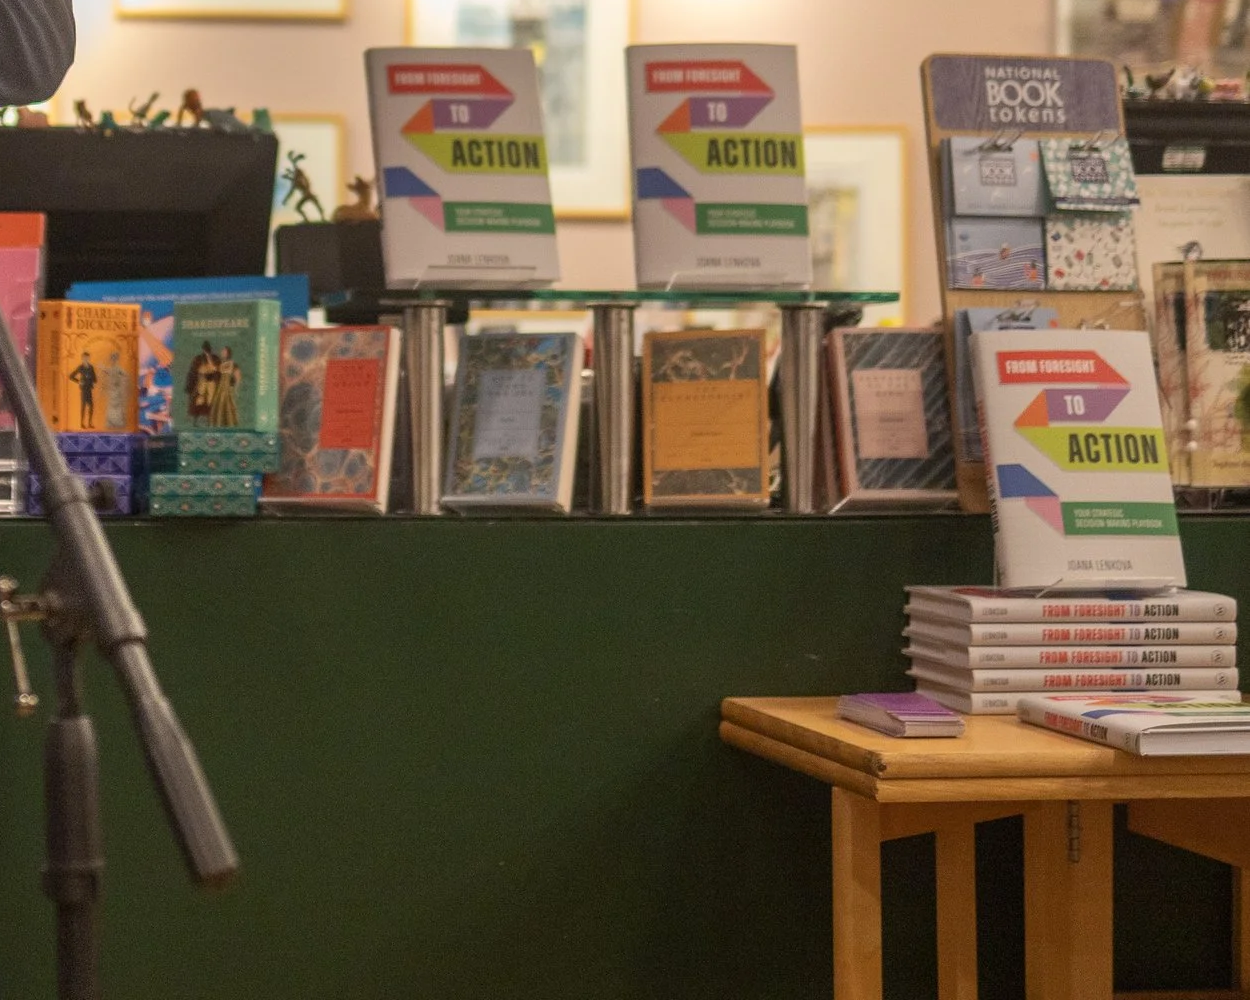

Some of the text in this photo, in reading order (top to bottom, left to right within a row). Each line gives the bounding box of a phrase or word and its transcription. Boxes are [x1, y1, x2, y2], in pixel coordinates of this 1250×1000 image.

[984, 66, 1060, 80] NATIONAL
[986, 80, 1064, 107] BOOK
[449, 103, 470, 124] TO
[707, 102, 728, 123] TO
[989, 107, 1066, 123] tokens
[452, 139, 541, 169] ACTION
[707, 138, 798, 169] ACTION
[76, 306, 128, 319] CHARLES
[76, 319, 128, 331] DICKENS
[181, 317, 249, 330] SHAKESPEARE
[1005, 359, 1096, 374] FROM FORESIGHT
[1063, 395, 1086, 416] TO
[1068, 433, 1160, 464] ACTION
[1042, 605, 1179, 618] FROM FORESIGHT TO ACTION
[1041, 628, 1179, 641] FROM FORESIGHT TO ACTION
[1039, 651, 1177, 664] FROM FORESIGHT TO ACTION
[1043, 674, 1181, 687] FROM FORESIGHT TO ACTION
